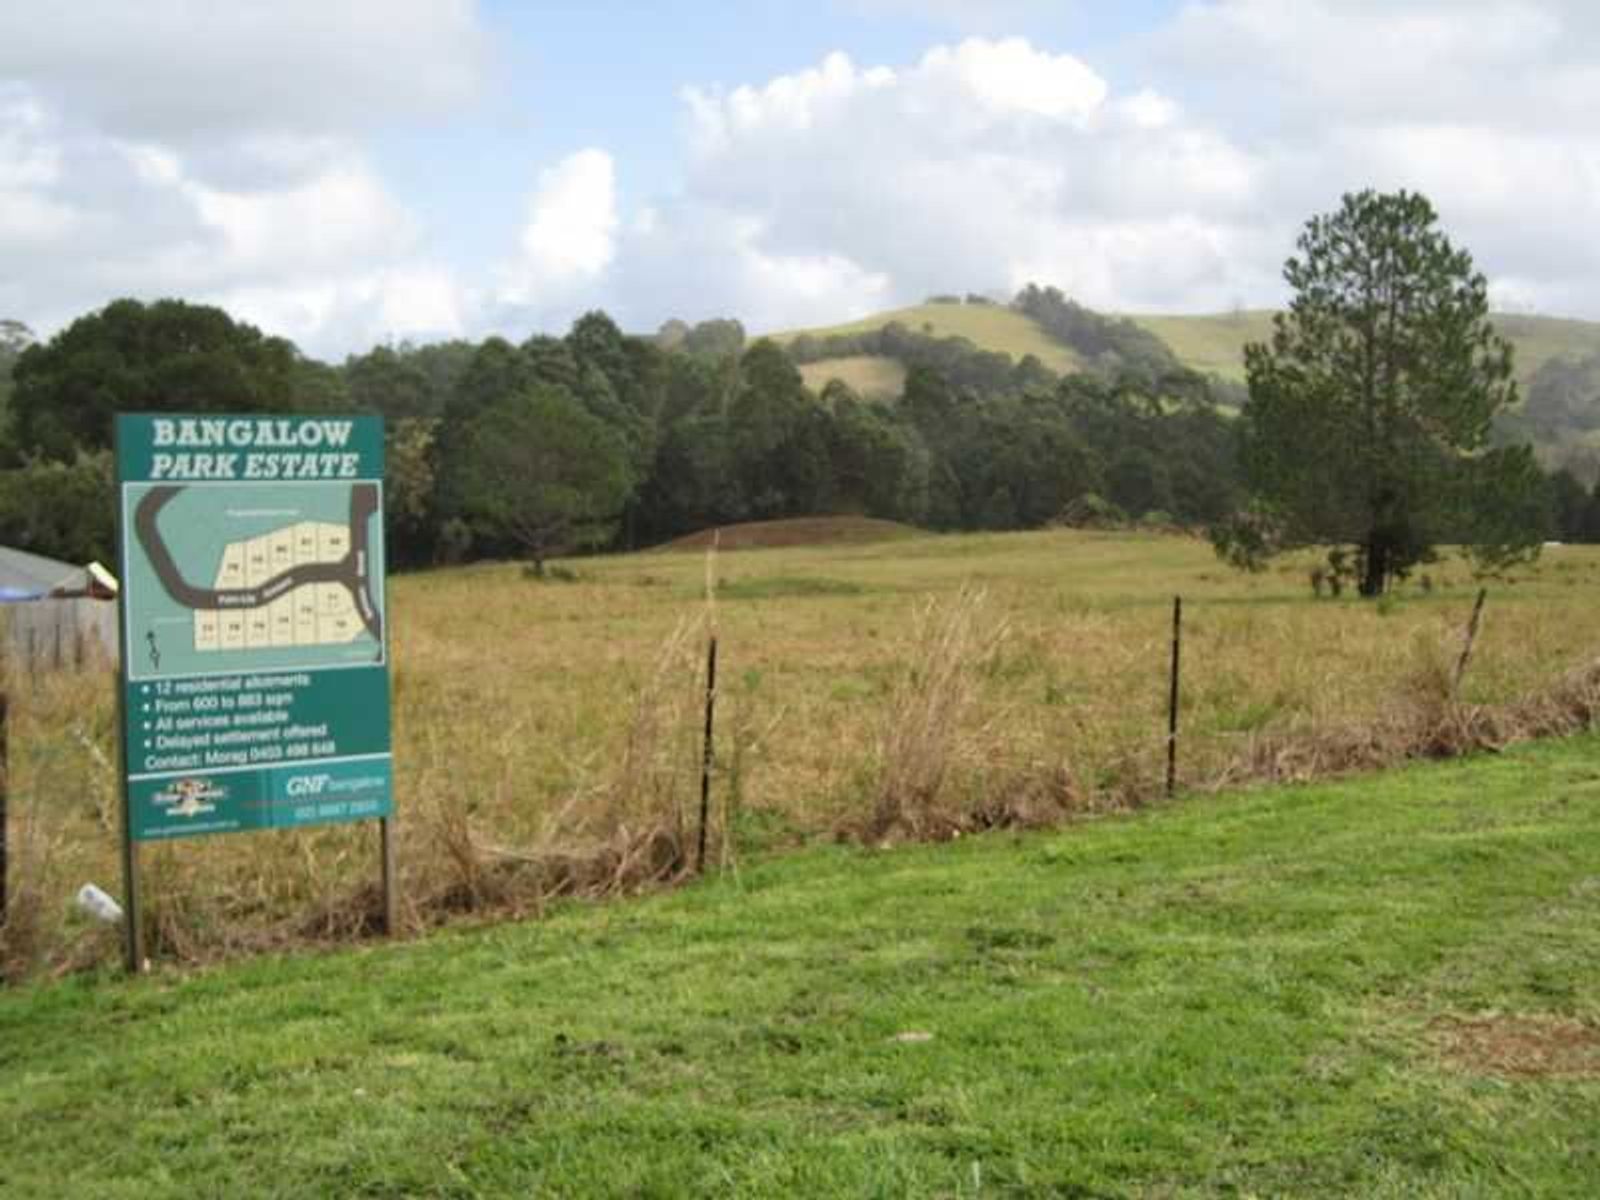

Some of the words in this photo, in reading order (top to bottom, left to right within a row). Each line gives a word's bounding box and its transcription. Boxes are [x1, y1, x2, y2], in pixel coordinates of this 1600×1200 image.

[153, 419, 353, 447] BANGALOW
[151, 453, 239, 479] PARK
[243, 452, 360, 478] ESTATE
[175, 677, 242, 694] residential
[155, 698, 191, 712] From
[221, 695, 235, 708] to
[155, 716, 173, 730] All
[176, 714, 229, 730] services
[233, 709, 289, 726] available
[156, 733, 210, 751] Delayed
[213, 727, 280, 744] settlement
[282, 723, 328, 739] offered
[204, 750, 248, 768] Morag
